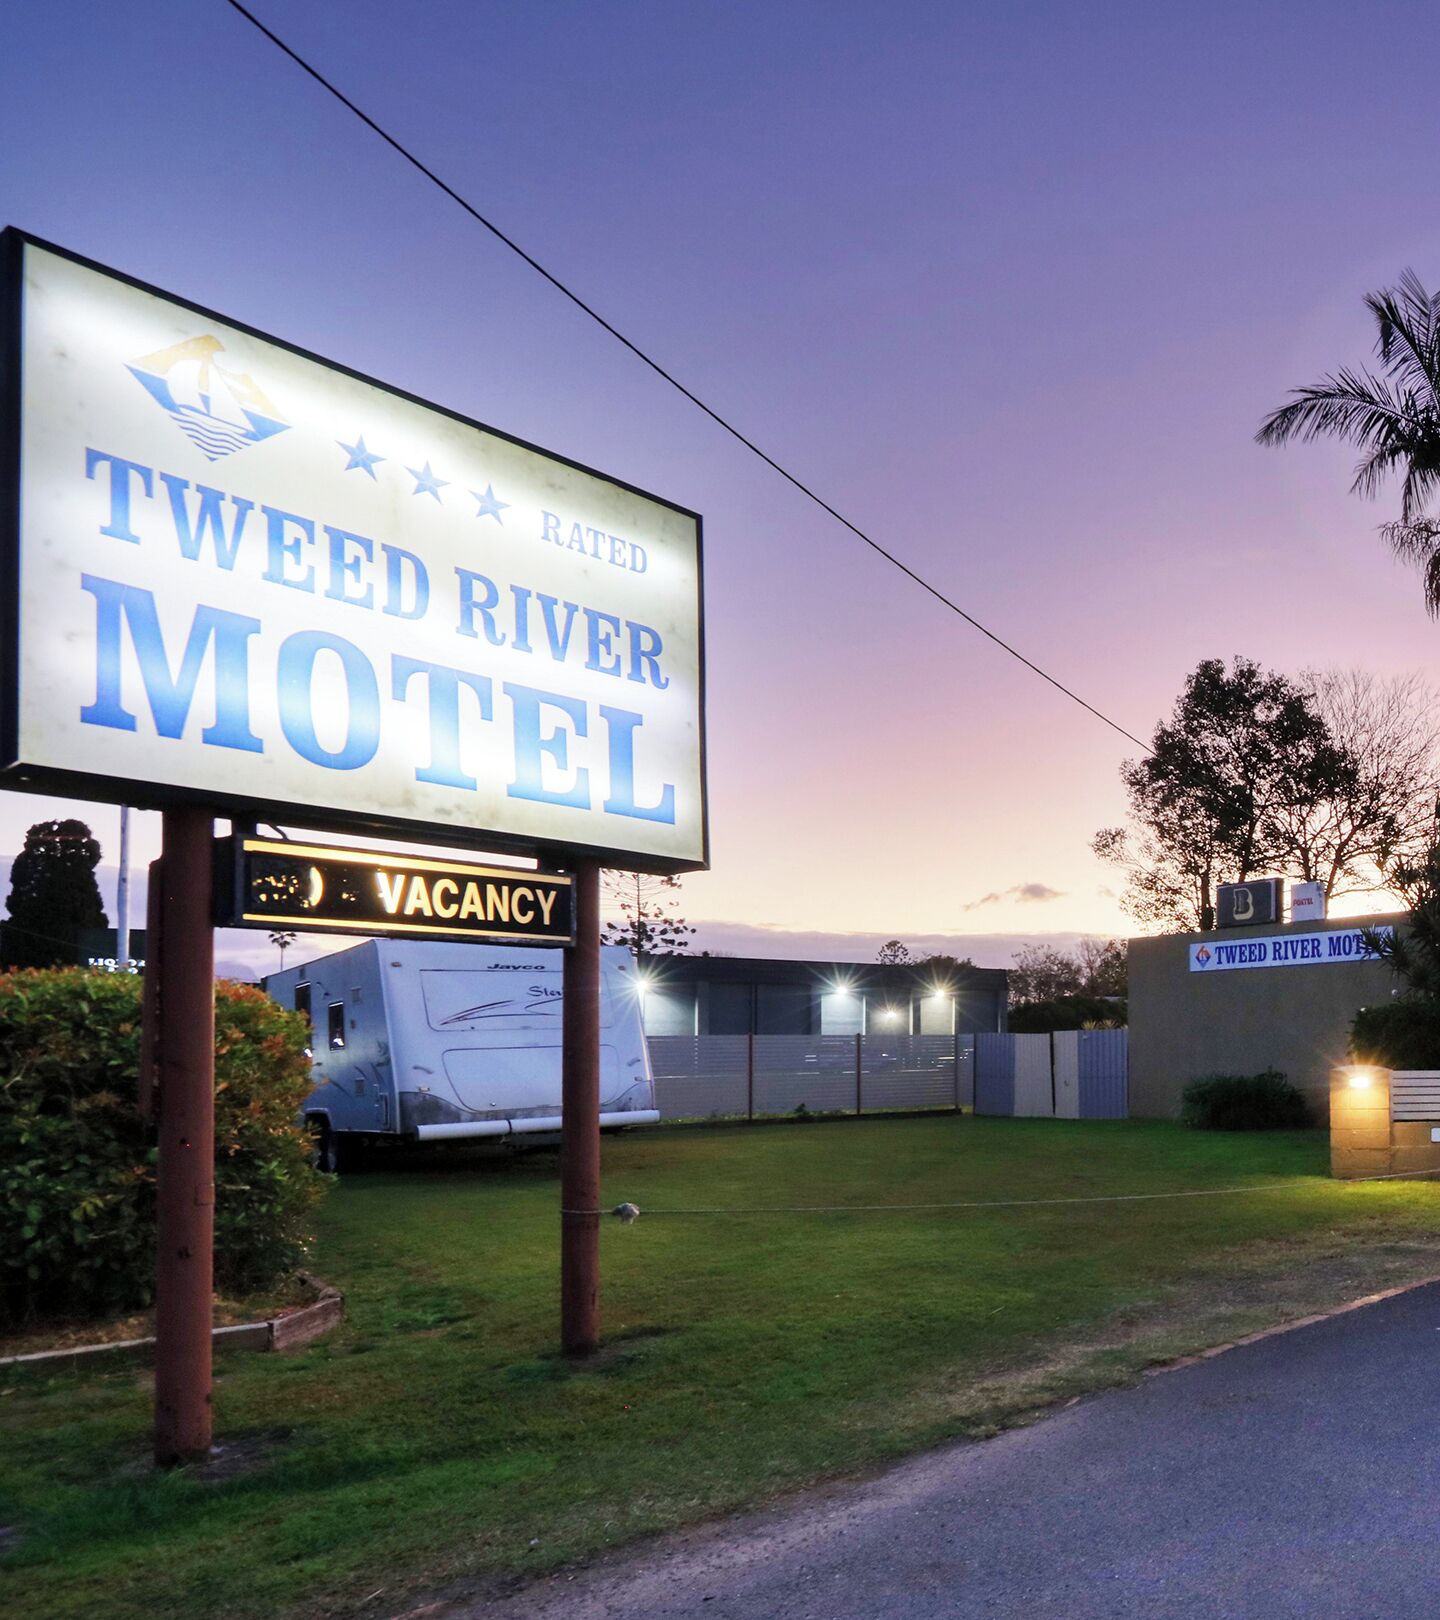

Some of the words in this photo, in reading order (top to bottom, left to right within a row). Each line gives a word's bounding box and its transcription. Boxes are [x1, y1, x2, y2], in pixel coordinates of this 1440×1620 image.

[85, 446, 430, 621] TWEED
[454, 566, 669, 690] RIVER
[540, 510, 648, 575] RATED
[80, 572, 676, 825] MOTEL
[376, 872, 556, 925] VACANCY
[1215, 942, 1267, 965] TWEED
[1272, 938, 1322, 961] RIVER
[1328, 933, 1373, 957] MOT
